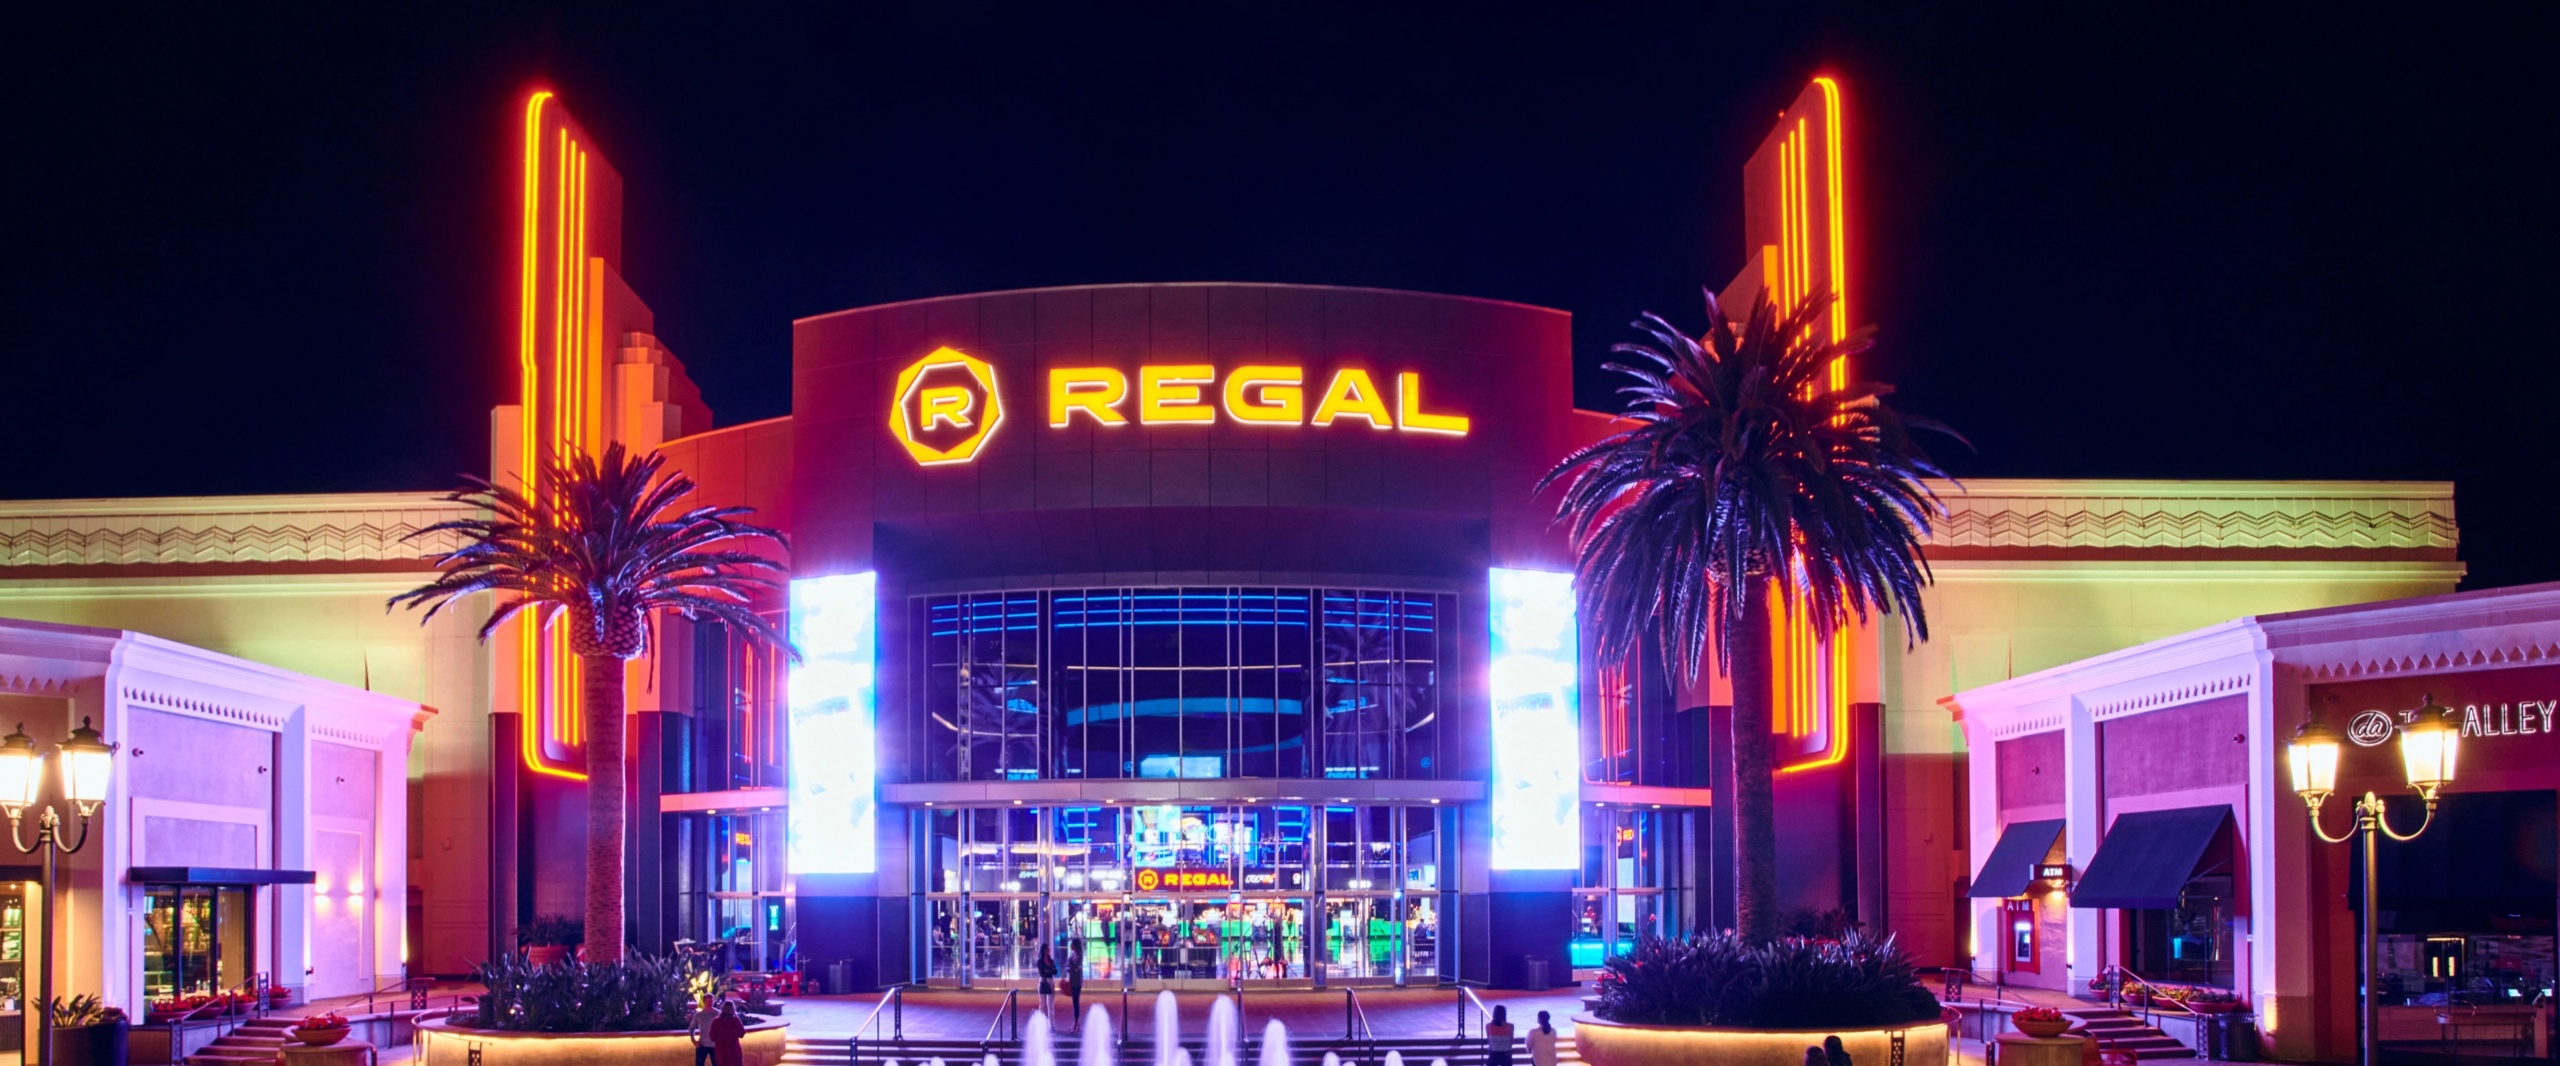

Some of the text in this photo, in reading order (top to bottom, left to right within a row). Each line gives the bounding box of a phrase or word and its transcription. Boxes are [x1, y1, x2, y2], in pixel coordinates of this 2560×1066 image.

[1049, 364, 1470, 436] REGAL
[2462, 700, 2557, 738] ALLEY
[1164, 873, 1234, 886] REGAL
[2043, 867, 2063, 877] ATM
